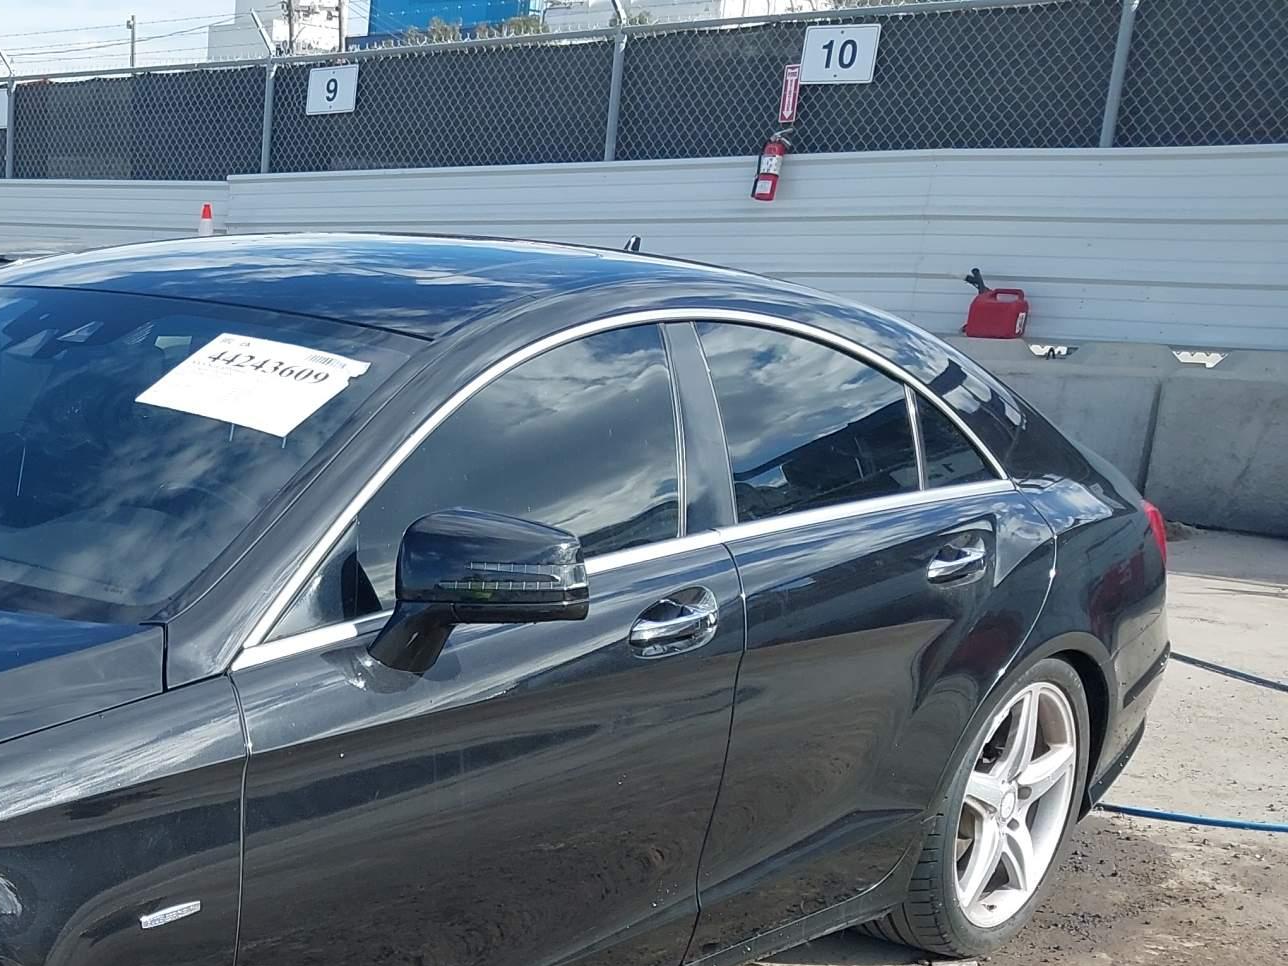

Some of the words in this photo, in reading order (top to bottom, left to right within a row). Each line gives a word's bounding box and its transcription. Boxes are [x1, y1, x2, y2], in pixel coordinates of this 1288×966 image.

[822, 39, 858, 69] 10
[326, 78, 338, 102] 9
[208, 350, 330, 384] 44243609
